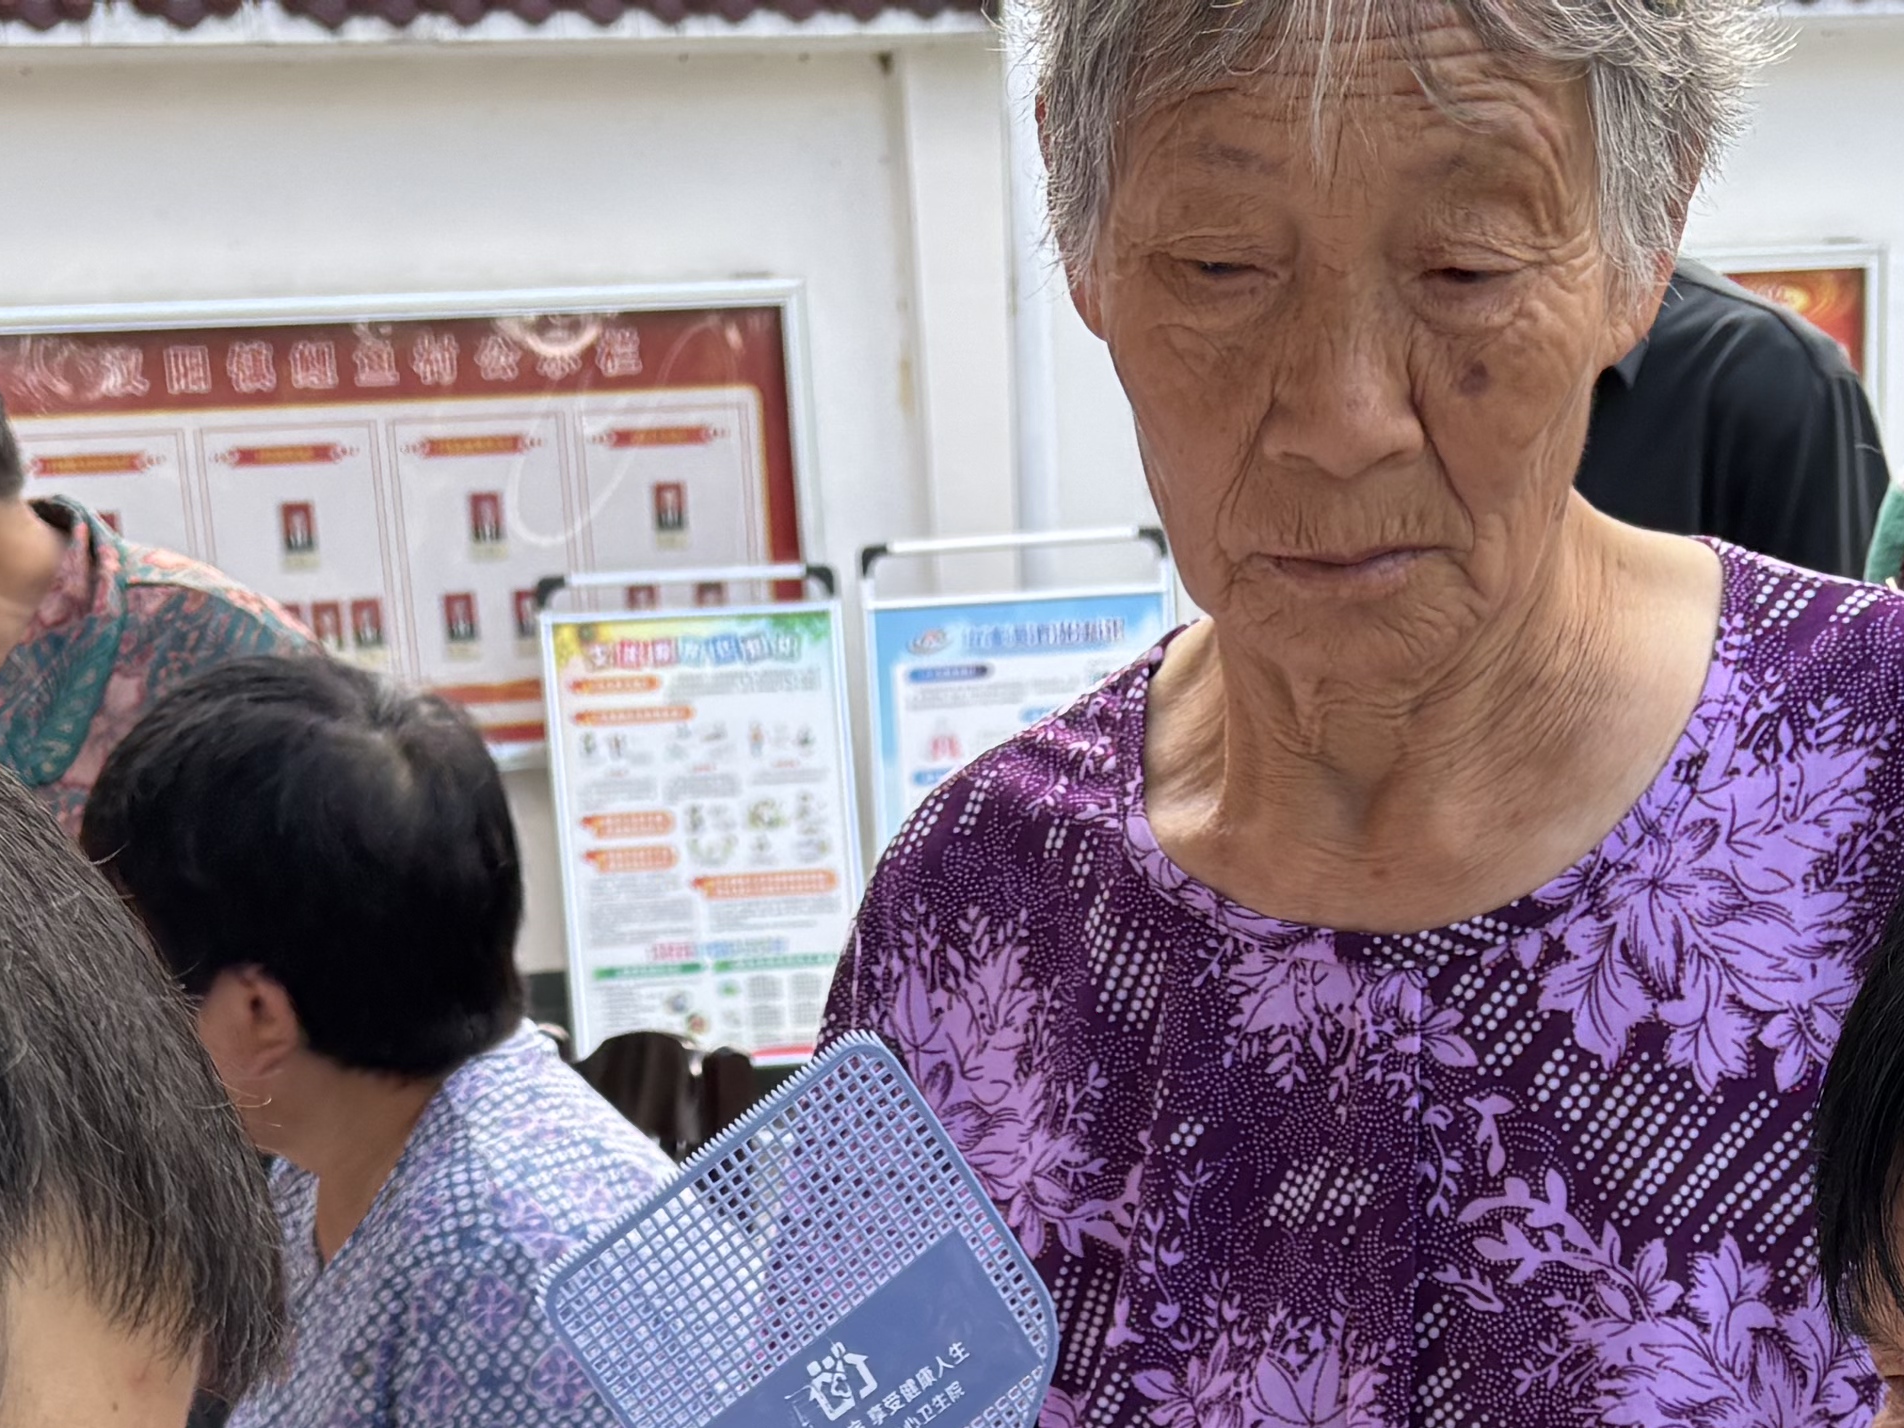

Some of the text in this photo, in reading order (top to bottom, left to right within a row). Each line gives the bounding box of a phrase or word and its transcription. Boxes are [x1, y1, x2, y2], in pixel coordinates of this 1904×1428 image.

[866, 1341, 971, 1426] 享受健康人生
